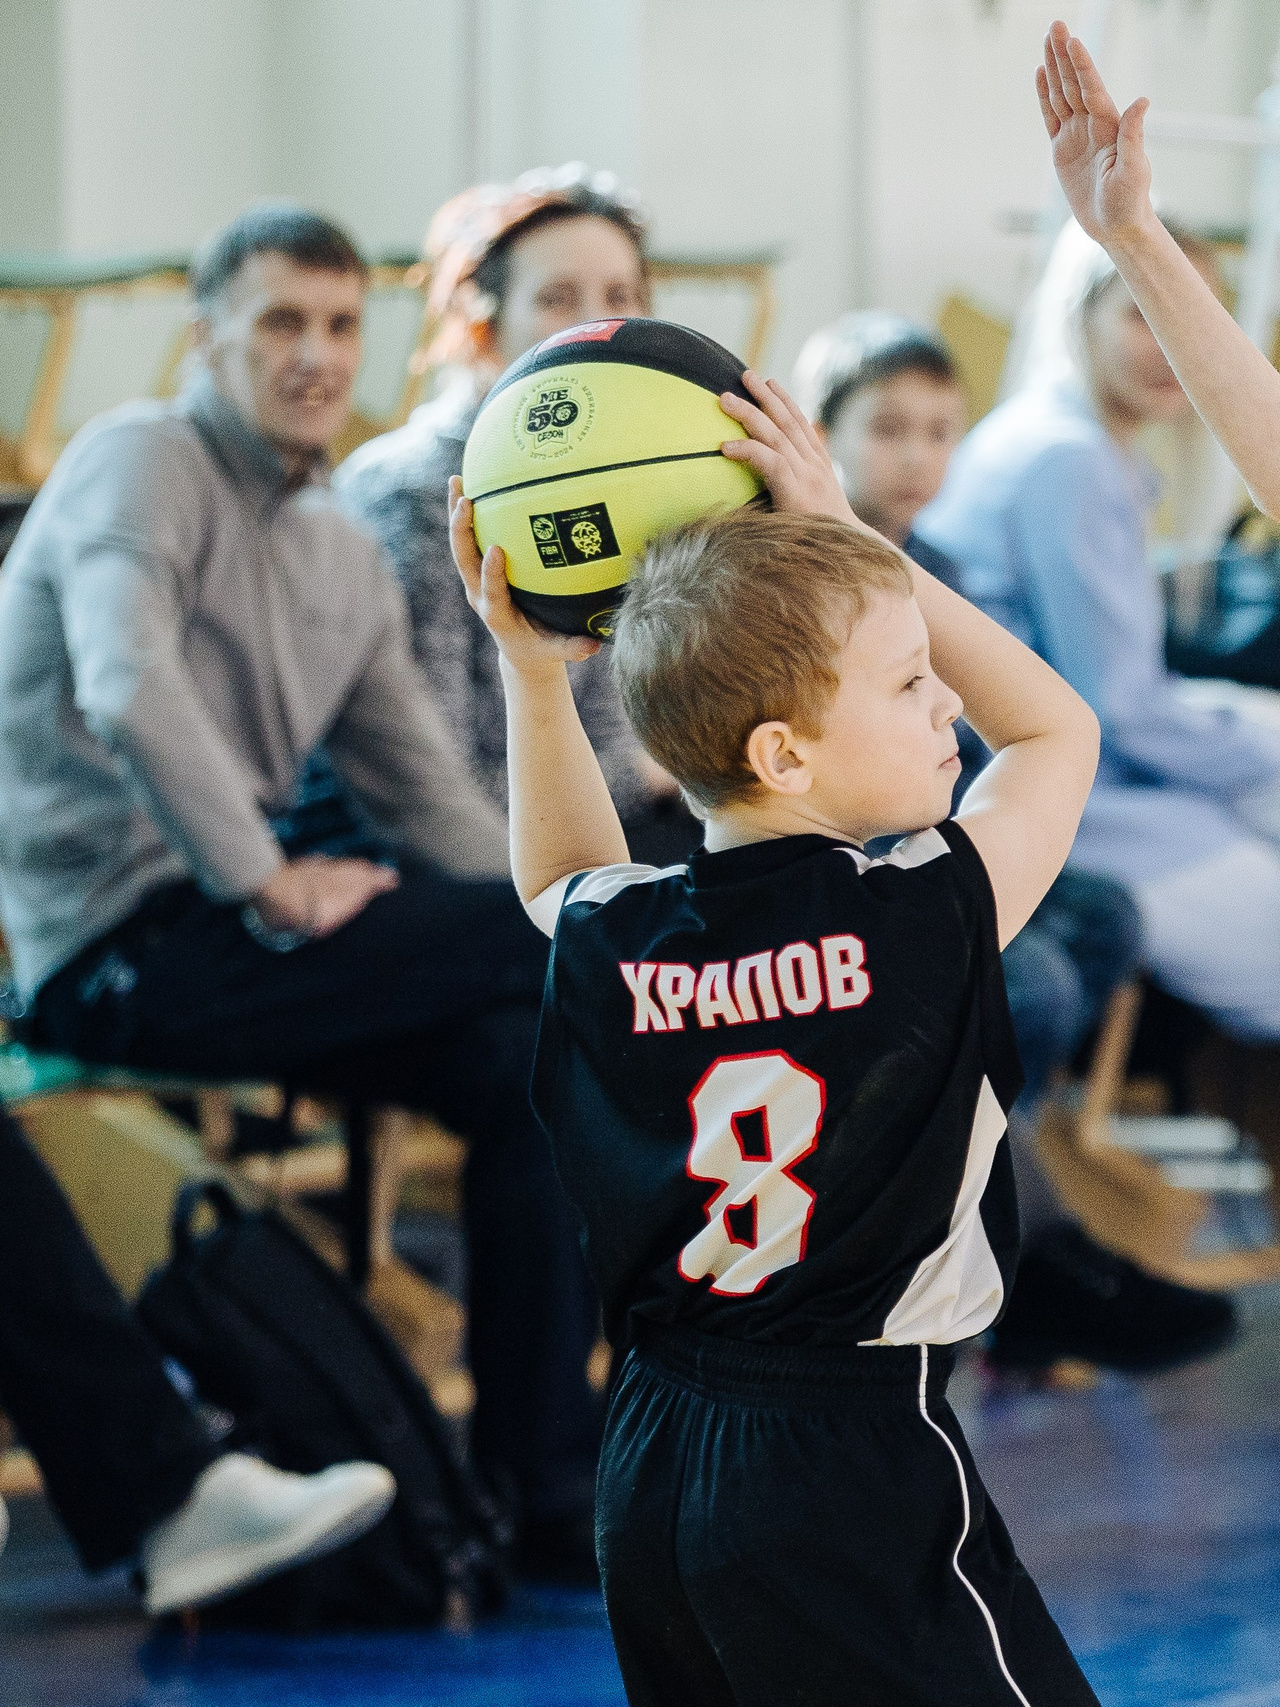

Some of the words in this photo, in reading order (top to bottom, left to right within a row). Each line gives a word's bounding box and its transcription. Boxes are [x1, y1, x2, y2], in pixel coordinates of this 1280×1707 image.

[526, 401, 578, 432] 50
[619, 933, 873, 1034] ХРАПОВ
[677, 1048, 827, 1298] 8
